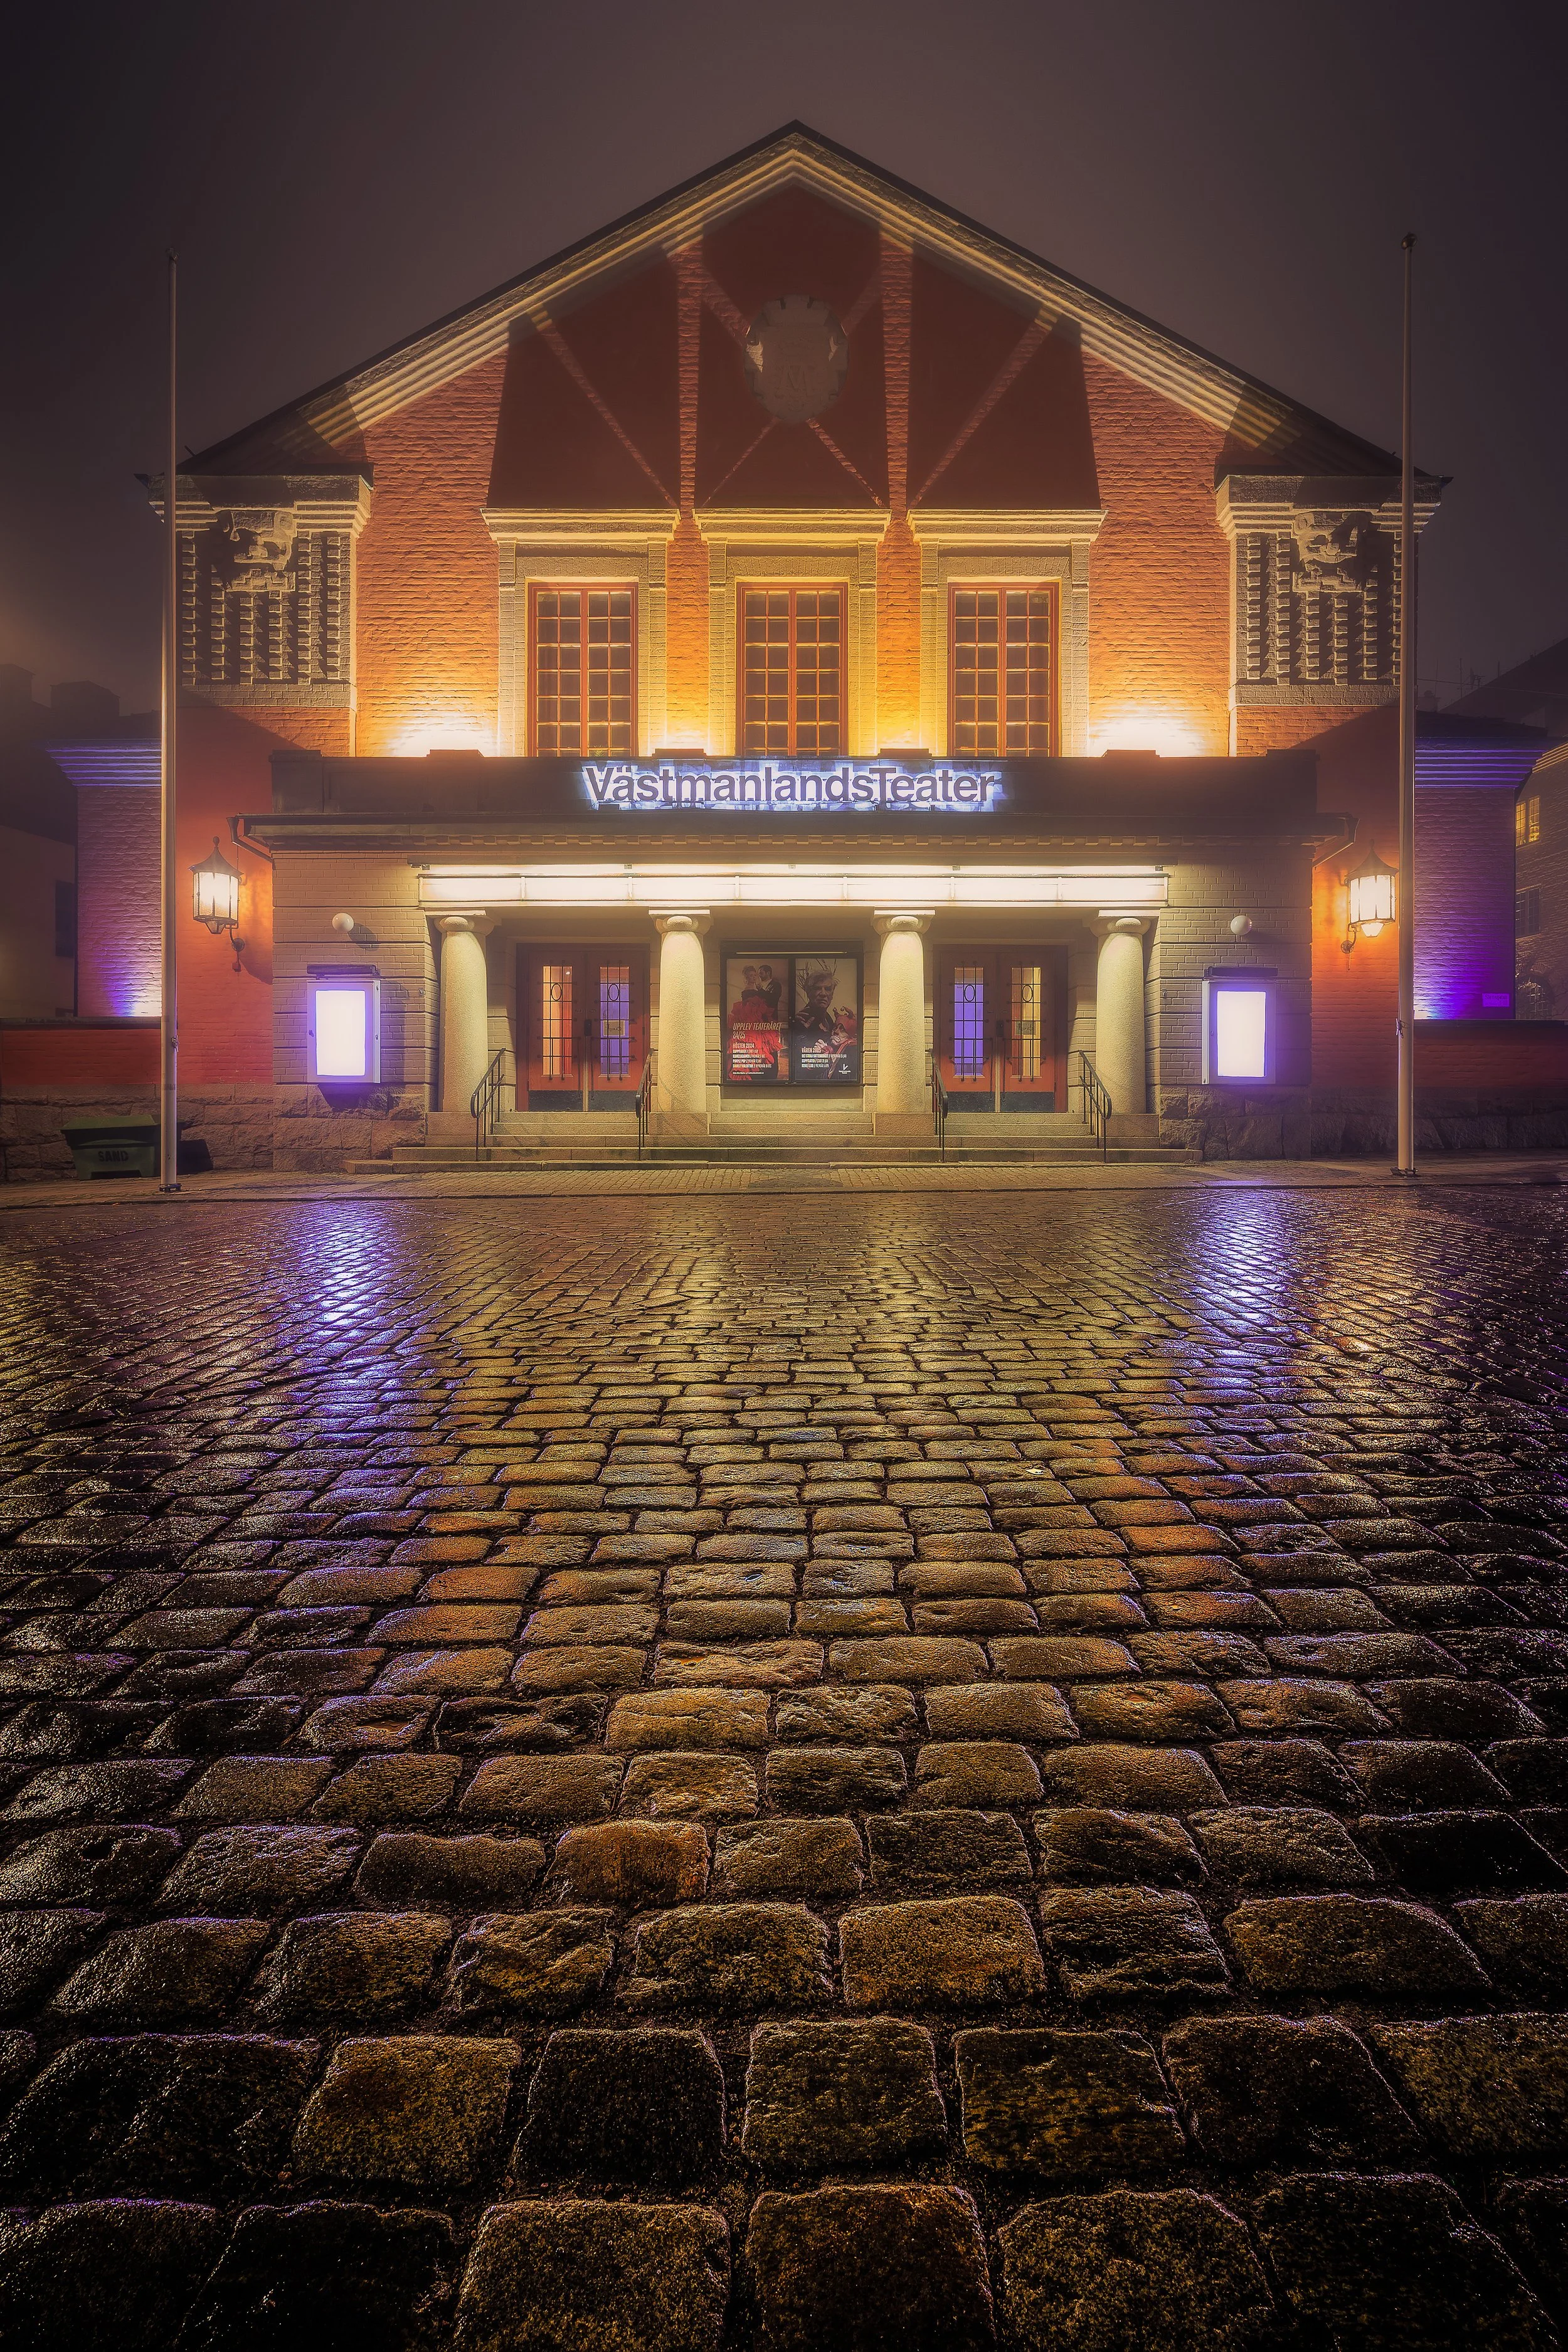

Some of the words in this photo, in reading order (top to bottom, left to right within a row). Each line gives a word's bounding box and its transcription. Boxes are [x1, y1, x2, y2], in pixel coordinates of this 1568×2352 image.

[585, 766, 995, 801] VästmanlandsTeater
[733, 1022, 752, 1030] UPPLEV
[753, 1020, 782, 1030] TEATERÅRET
[733, 1030, 746, 1039] 24/25
[98, 1150, 129, 1162] SAND
